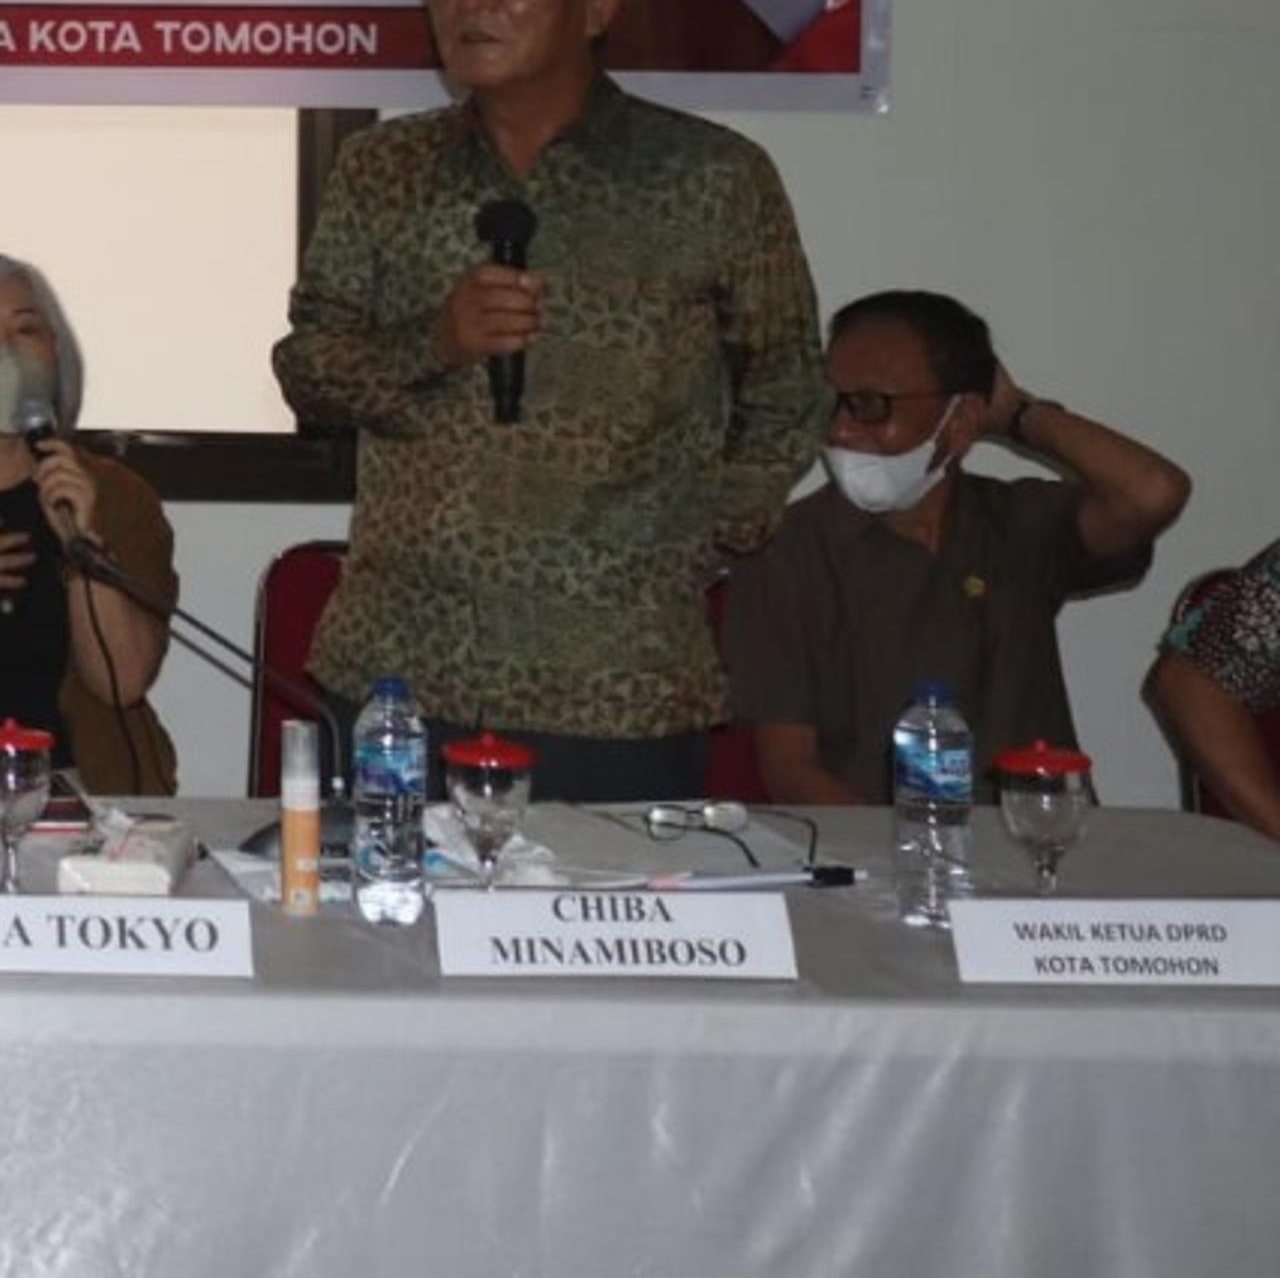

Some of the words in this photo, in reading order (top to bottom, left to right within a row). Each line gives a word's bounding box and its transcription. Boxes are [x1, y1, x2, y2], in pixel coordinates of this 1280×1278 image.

[29, 21, 141, 54] KOTA
[155, 21, 378, 56] TOMOHON
[552, 893, 674, 923] CHIBA
[47, 915, 219, 953] TOKYO
[1013, 923, 1083, 942] WAKIL
[1091, 923, 1160, 942] KETUA
[1166, 924, 1228, 943] DPRD
[491, 937, 747, 967] MINAMIBOSO
[1034, 957, 1094, 974] KOTA
[1100, 957, 1220, 975] TOMOHON
